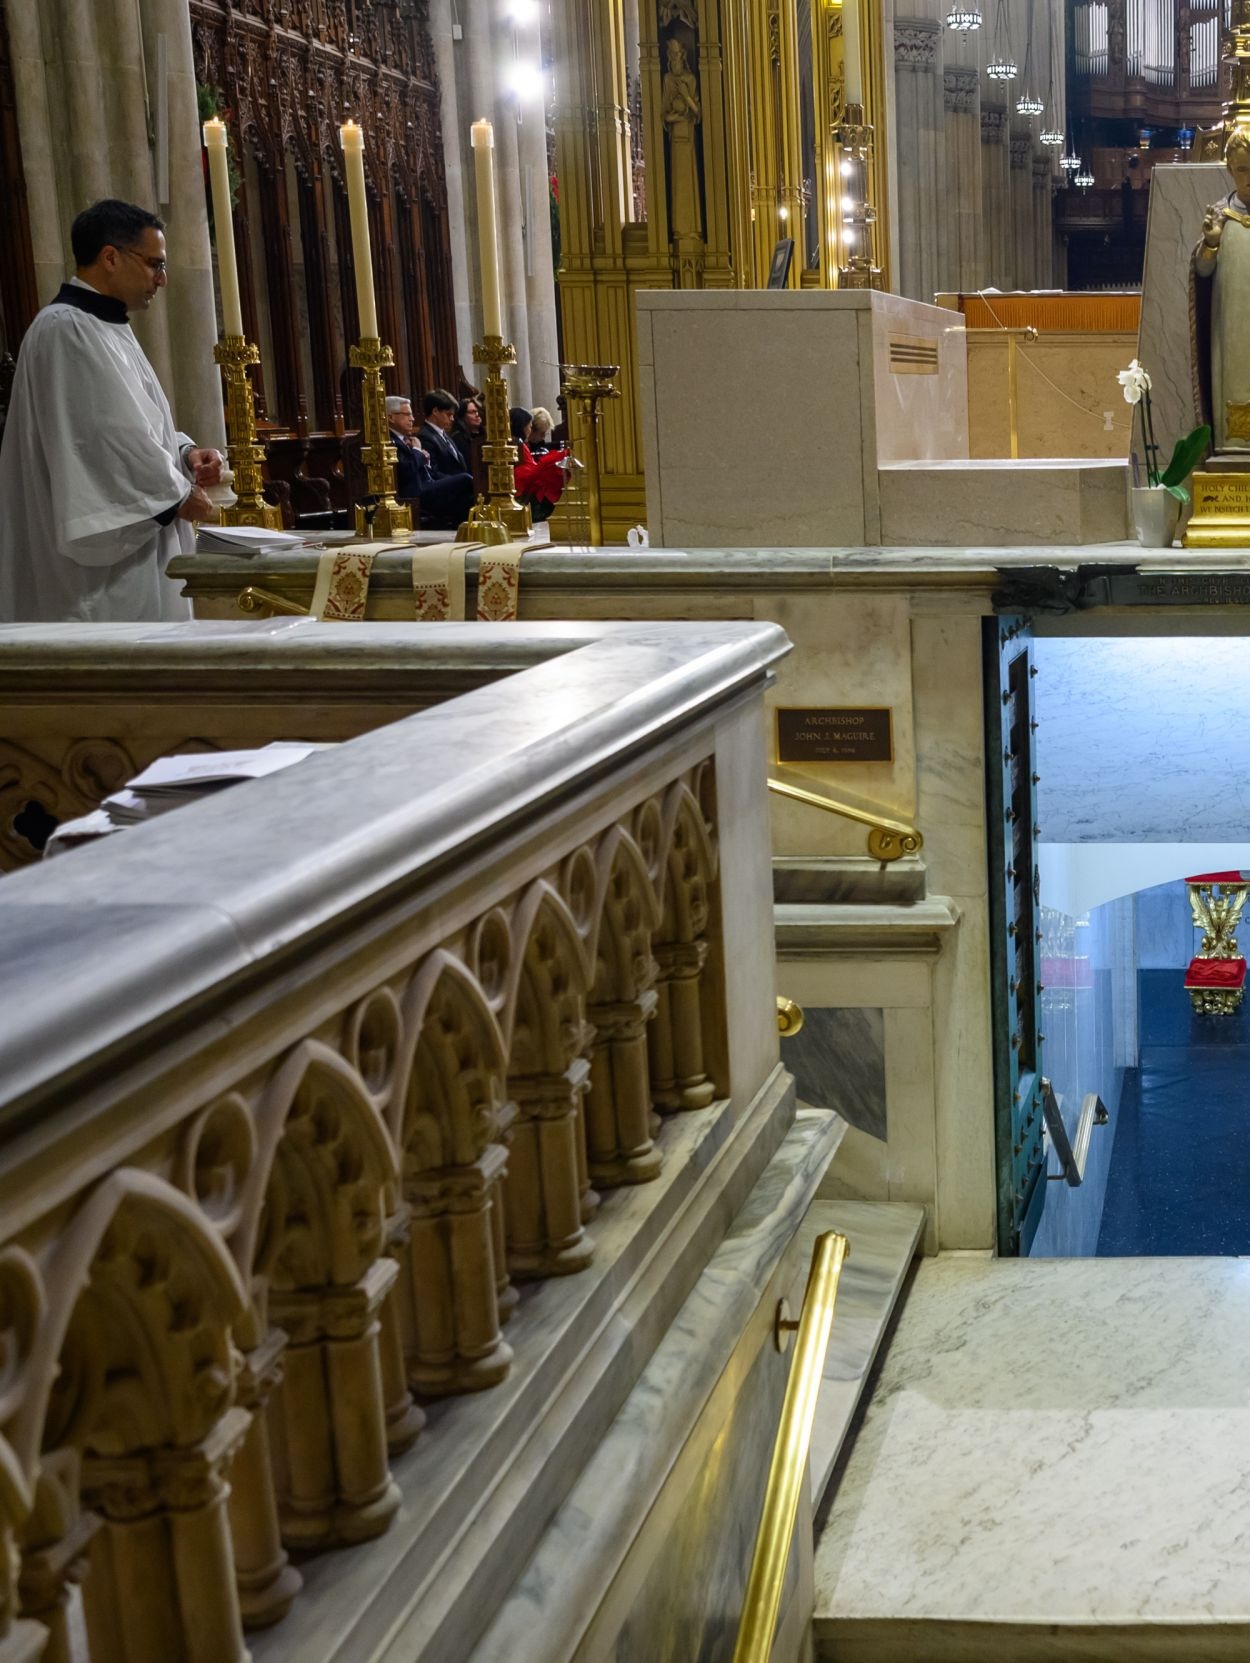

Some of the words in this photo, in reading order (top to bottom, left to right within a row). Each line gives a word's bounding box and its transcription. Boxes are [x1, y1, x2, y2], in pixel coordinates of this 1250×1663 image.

[1201, 484, 1226, 493] HOLY
[1200, 505, 1211, 513] WE
[1137, 585, 1166, 596] THE
[804, 716, 865, 726] ARCHBISHOP
[794, 732, 821, 741] JOHN
[833, 732, 876, 741] MAGUIRE
